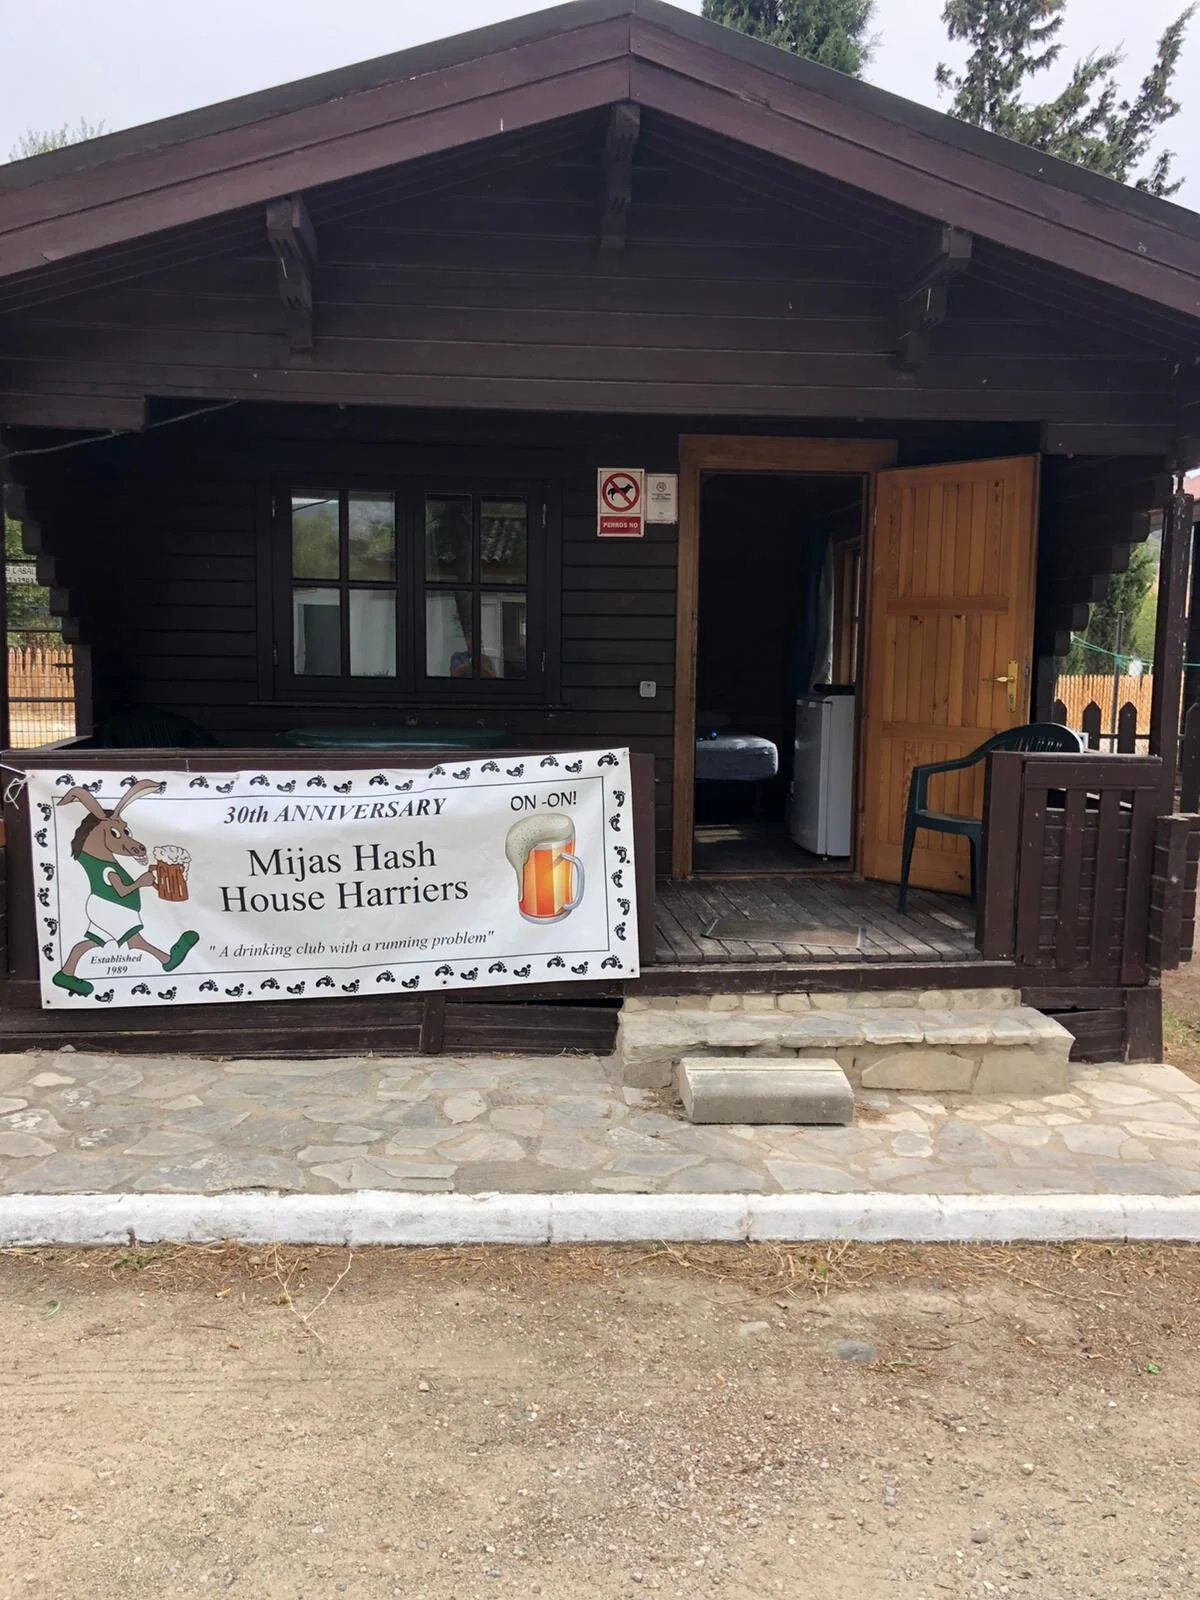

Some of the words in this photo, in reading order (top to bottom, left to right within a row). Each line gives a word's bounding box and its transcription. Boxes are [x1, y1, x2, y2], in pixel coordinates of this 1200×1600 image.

[603, 521, 628, 529] PERROS
[629, 521, 639, 529] NO
[223, 805, 269, 824] 30th
[274, 797, 447, 823] ANNIVERSARY
[510, 794, 537, 811] ON
[247, 847, 342, 882] Mijas
[352, 840, 437, 872] Hash
[219, 886, 326, 913] House
[336, 876, 469, 910] Harriers
[233, 943, 292, 958] drinking
[296, 941, 326, 955] club
[329, 941, 358, 954] with
[362, 943, 371, 952] a
[374, 935, 429, 953] running
[431, 930, 494, 949] problem"
[90, 954, 142, 965] Established
[106, 965, 129, 976] 1989
